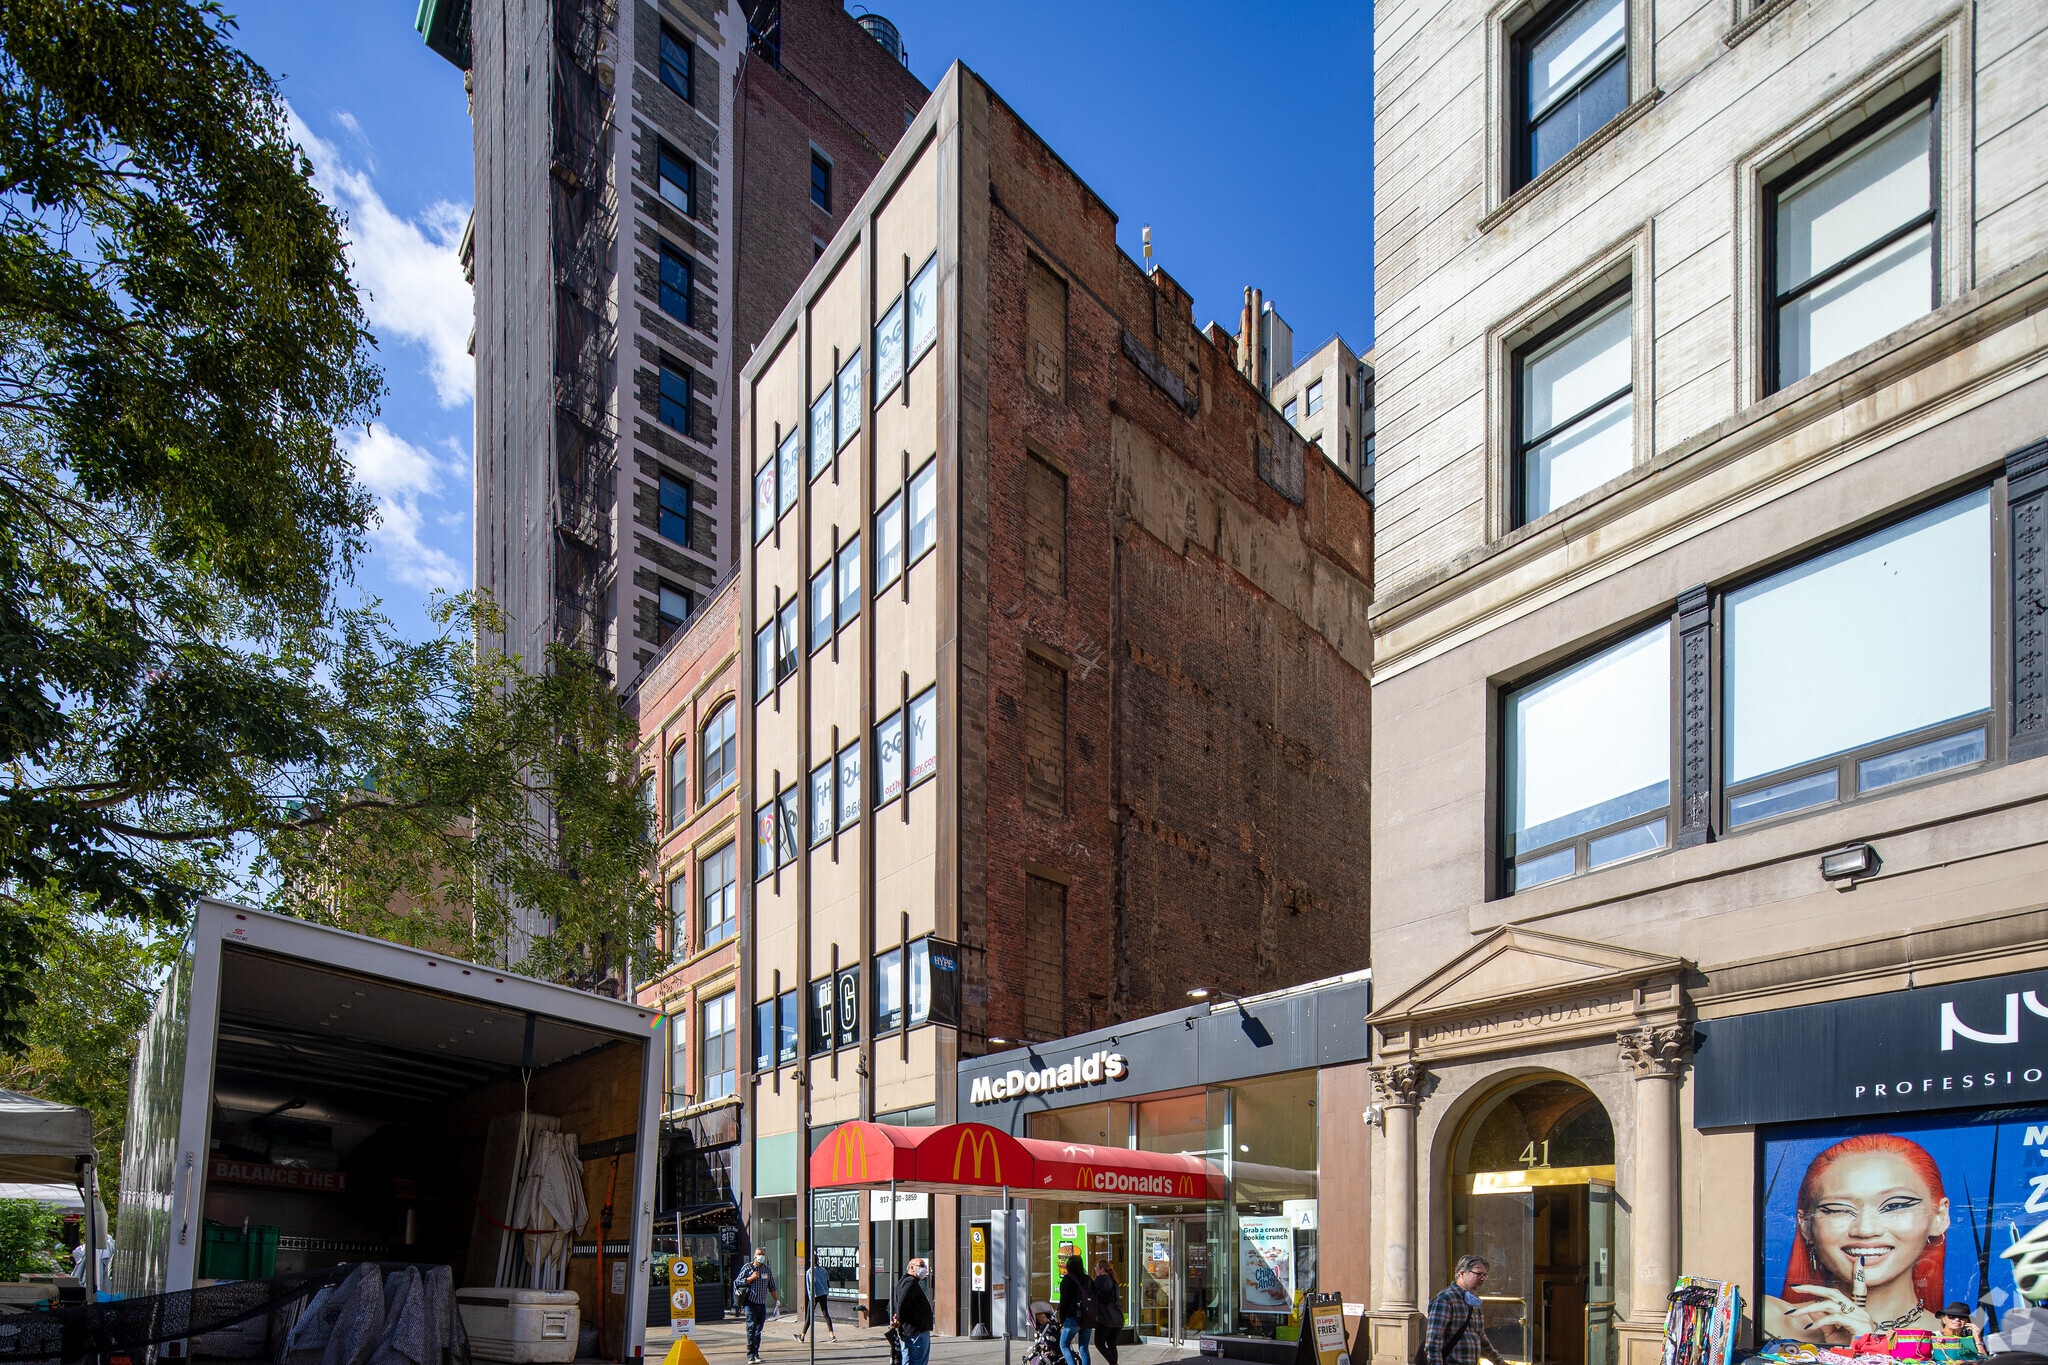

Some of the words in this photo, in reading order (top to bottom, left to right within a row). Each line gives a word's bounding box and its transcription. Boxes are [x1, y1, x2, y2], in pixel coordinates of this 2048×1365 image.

[934, 956, 953, 969] HYPE
[1424, 1015, 1500, 1043] UNION
[1513, 994, 1623, 1029] SQUARE
[970, 1050, 1126, 1104] McDonald's
[1519, 1139, 1551, 1168] 41
[216, 1162, 298, 1185] BALANCE
[302, 1171, 334, 1188] THE
[1076, 1166, 1173, 1195] McDonald's
[837, 1193, 860, 1221] GYM
[1175, 1205, 1183, 1213] 39
[1301, 1212, 1311, 1225] A
[975, 1233, 980, 1243] 3
[676, 1263, 685, 1274] 2
[818, 1256, 830, 1268] 917)
[1255, 1268, 1275, 1280] Chips
[1317, 1325, 1337, 1335] FRIES
